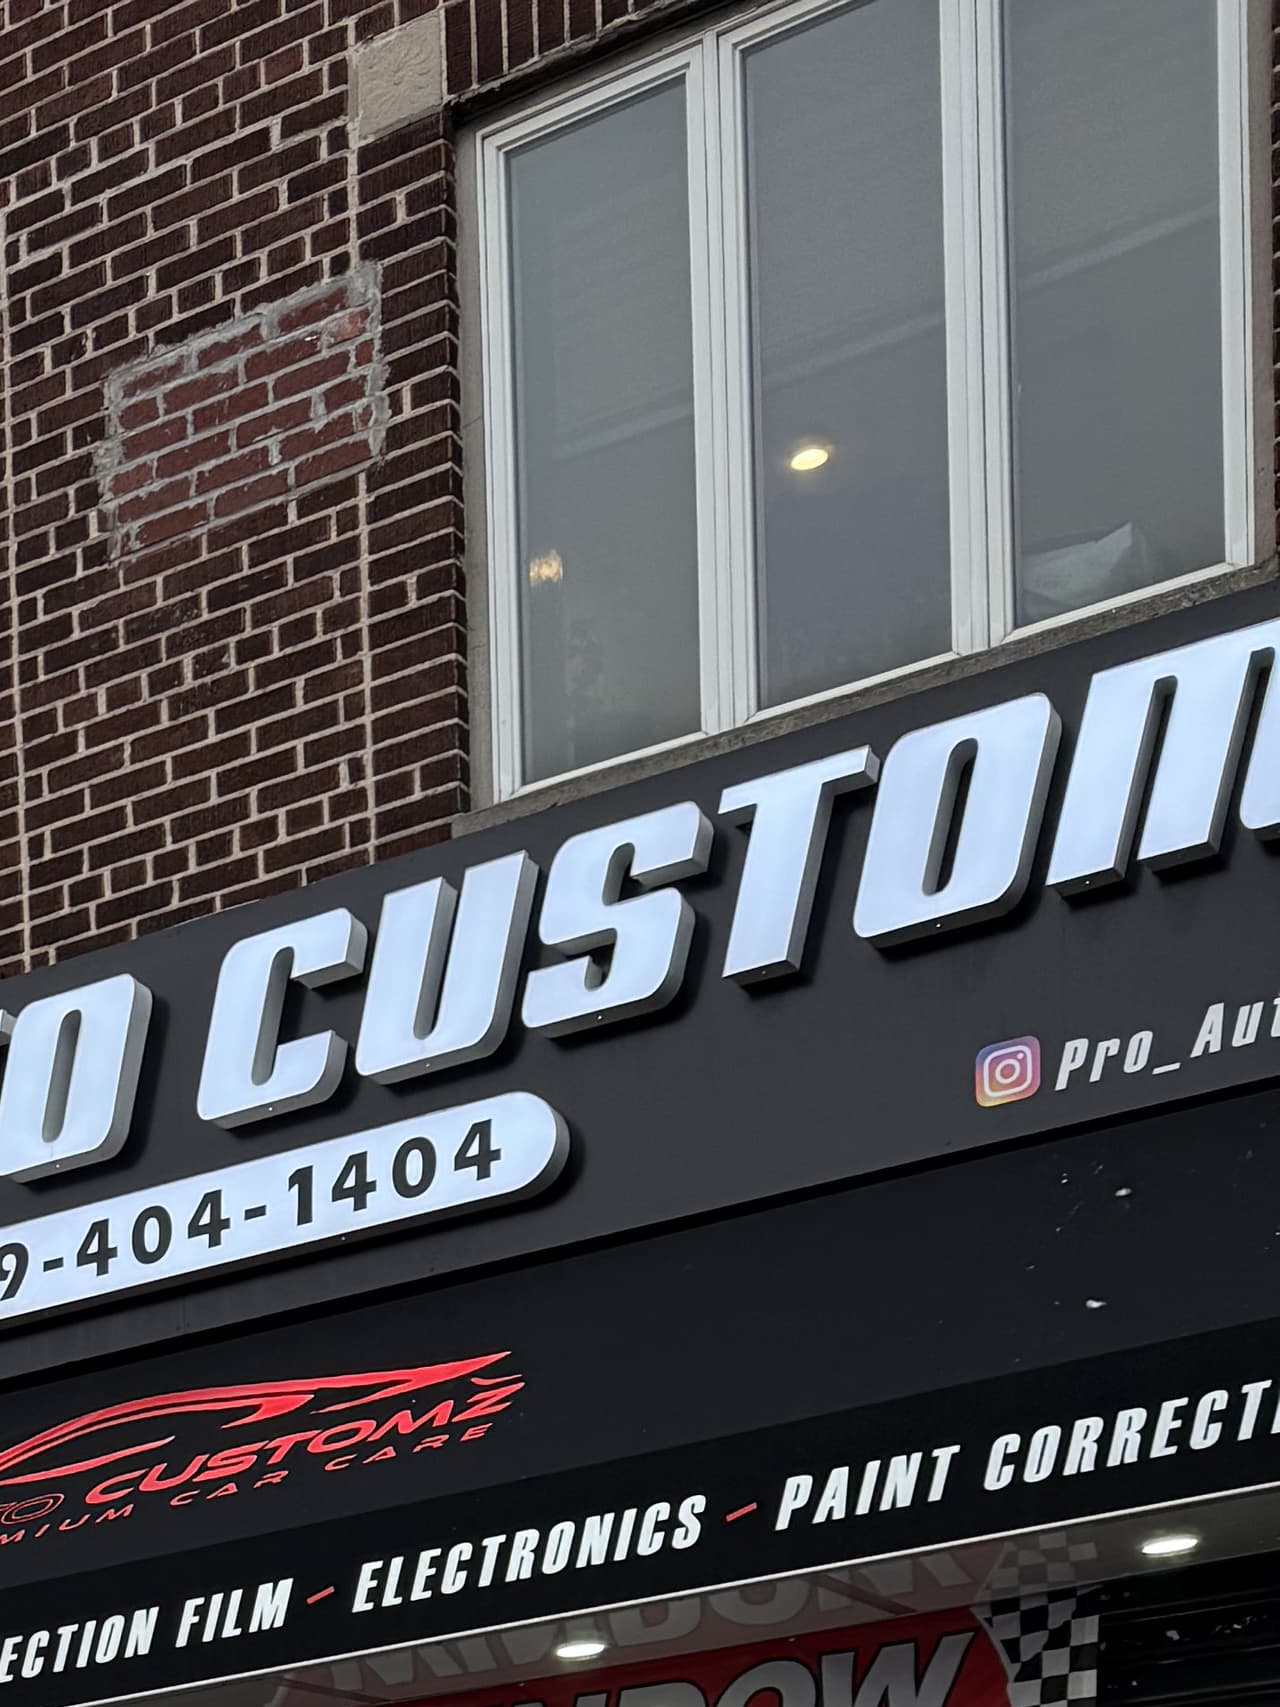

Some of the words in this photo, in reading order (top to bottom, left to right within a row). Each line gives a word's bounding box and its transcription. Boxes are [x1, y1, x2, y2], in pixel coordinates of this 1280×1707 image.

[86, 1374, 525, 1504] CUSTOMZ
[171, 1470, 285, 1506] CAR
[325, 1423, 492, 1473] CARE
[175, 1578, 294, 1648] FILM
[351, 1494, 708, 1614] ELECTRONICS
[774, 1446, 960, 1531] PAINT
